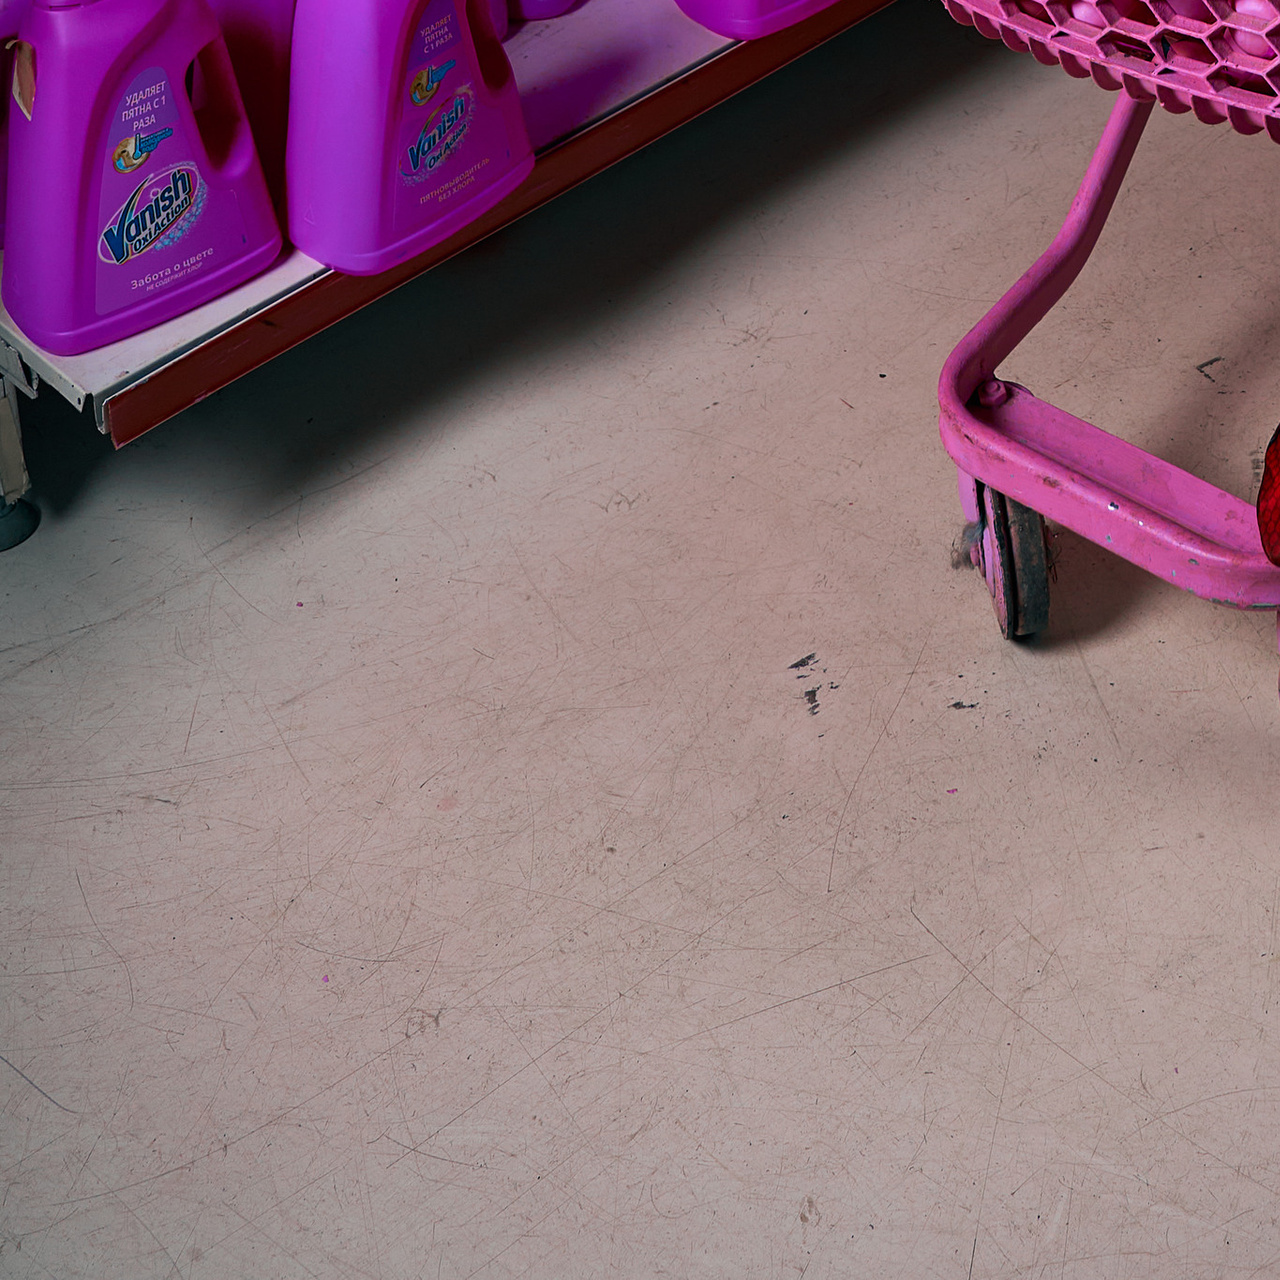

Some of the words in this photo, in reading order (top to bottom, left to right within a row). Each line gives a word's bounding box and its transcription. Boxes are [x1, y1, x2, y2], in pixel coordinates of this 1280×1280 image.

[420, 14, 452, 39] УДАЛЯЕТ
[126, 81, 166, 108] УДАЛЯЕТ
[121, 101, 152, 122] ПЯТНА
[153, 99, 160, 109] С
[161, 95, 166, 105] 1
[132, 113, 156, 132] РАЗА
[407, 96, 465, 172] Vanish
[103, 169, 192, 265] Vanish
[131, 266, 171, 290] Забота
[173, 263, 181, 272] о
[182, 247, 214, 268] цвете
